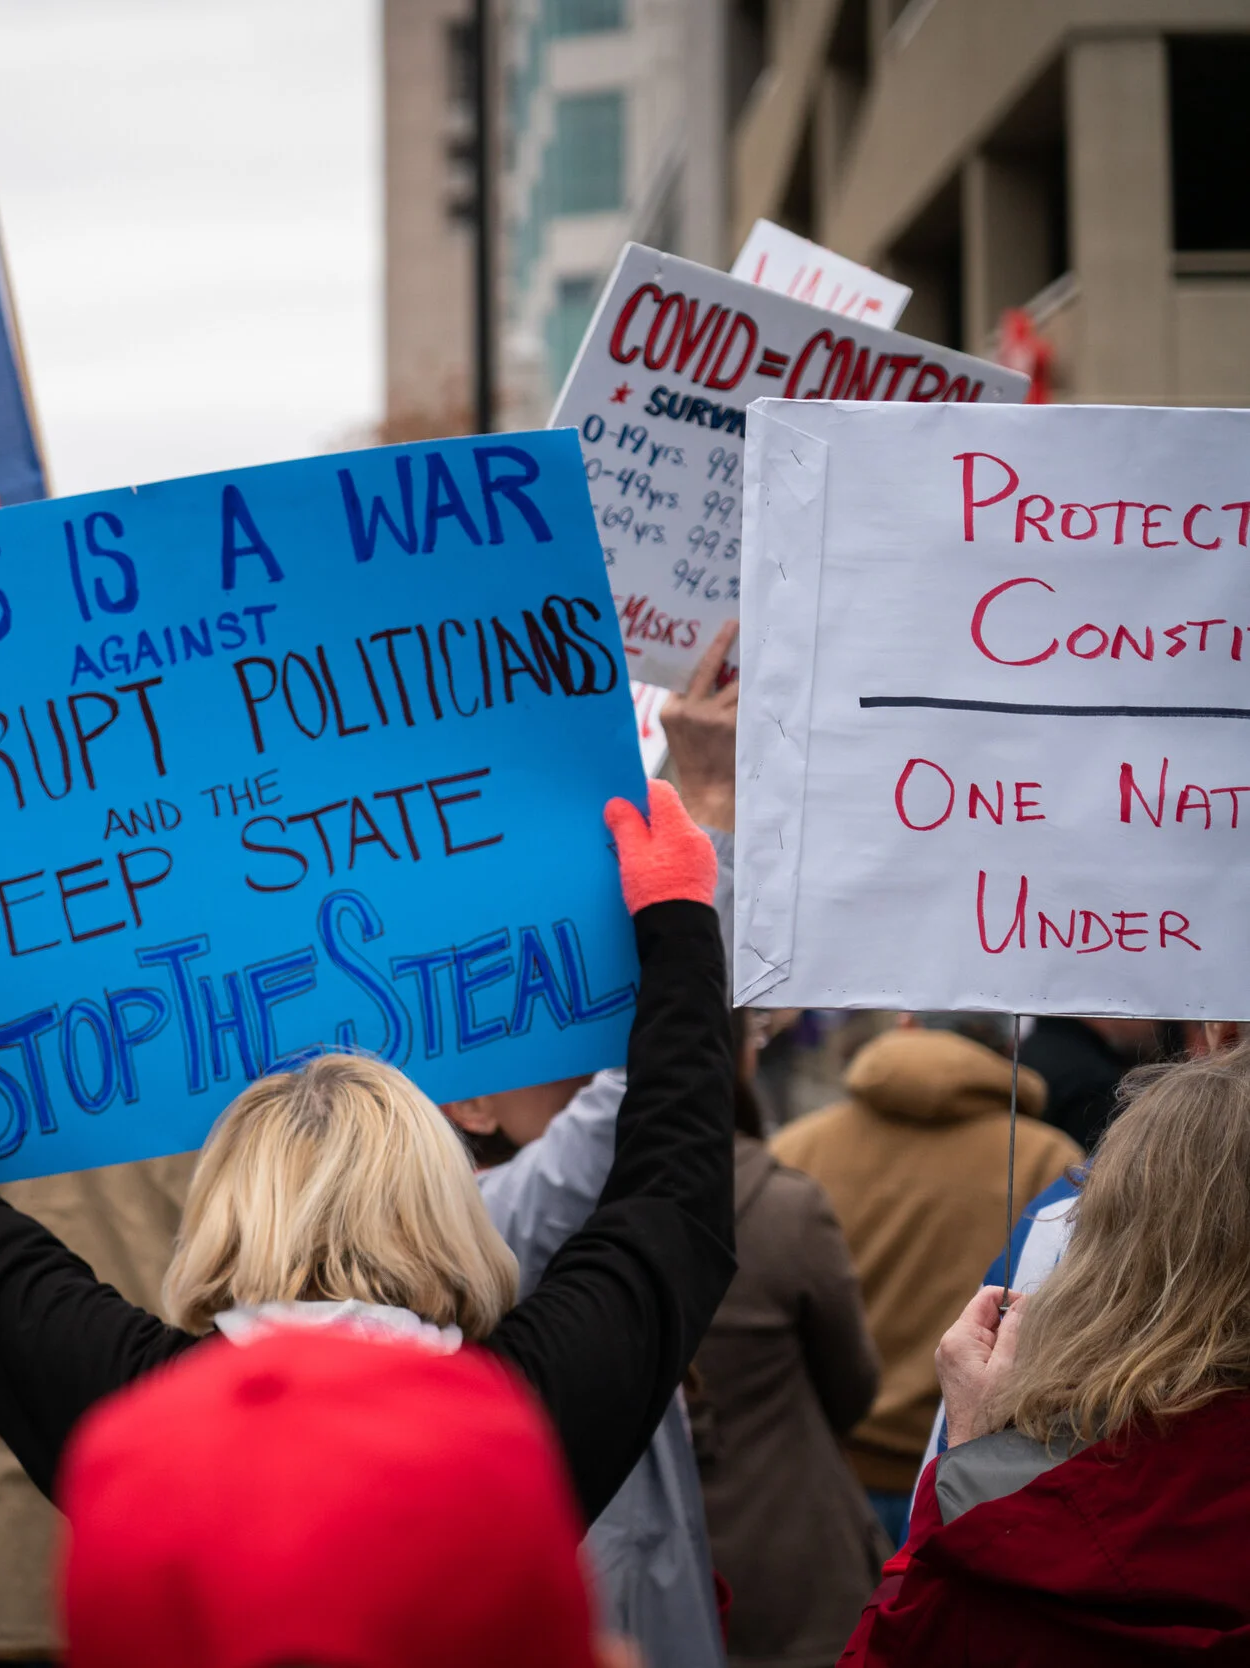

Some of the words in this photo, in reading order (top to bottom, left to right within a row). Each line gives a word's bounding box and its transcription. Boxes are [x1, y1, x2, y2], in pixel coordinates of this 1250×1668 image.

[62, 511, 141, 623] IS
[221, 483, 285, 592] A
[337, 445, 554, 563] WAR
[952, 451, 1250, 550] PROTECT
[69, 603, 279, 687] AGAINST
[970, 576, 1250, 667] CONSTI
[103, 797, 183, 840] AND
[200, 767, 284, 818] THE
[241, 767, 505, 892] STATE
[894, 757, 1047, 832] ONE
[976, 869, 1203, 955] UNDER
